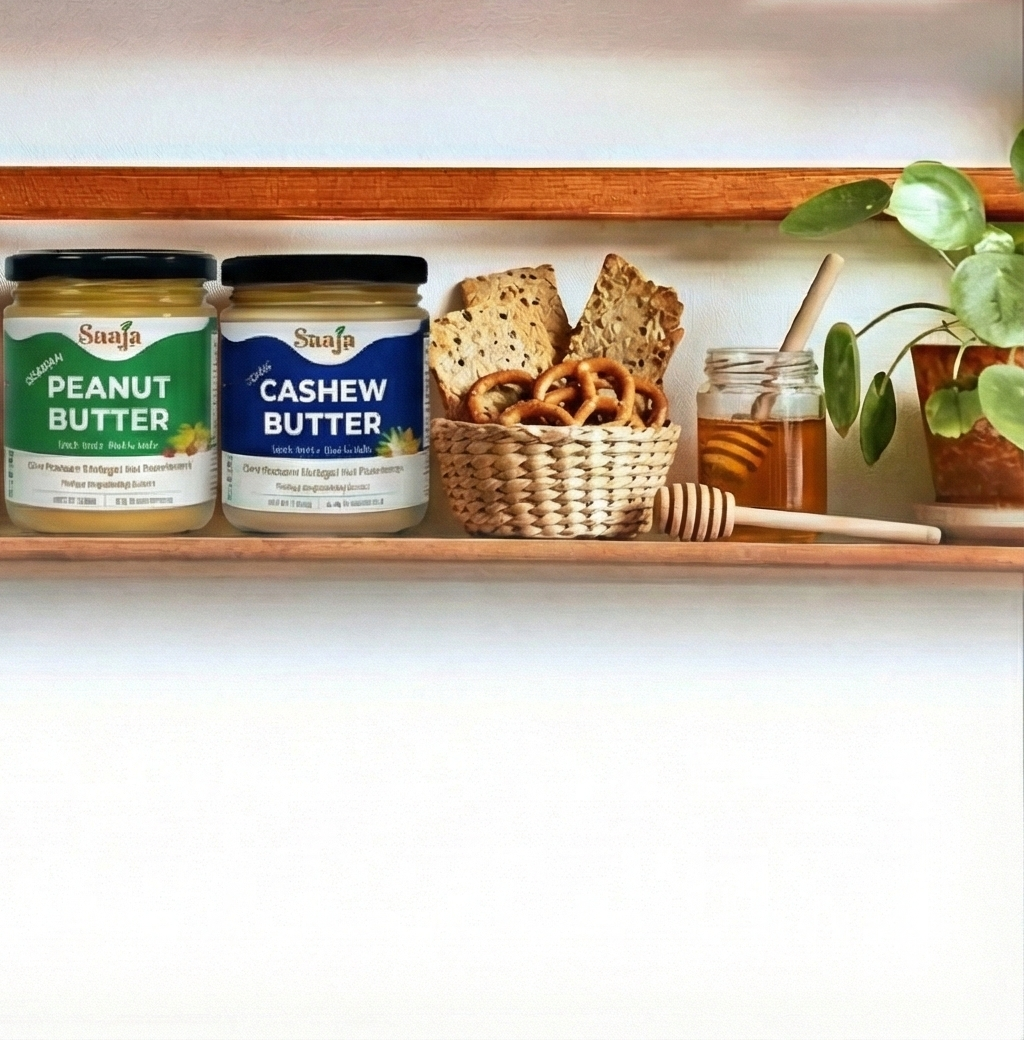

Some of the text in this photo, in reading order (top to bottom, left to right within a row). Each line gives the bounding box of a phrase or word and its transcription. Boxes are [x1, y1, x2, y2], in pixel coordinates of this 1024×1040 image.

[47, 375, 171, 400] PEANUT
[259, 378, 388, 403] CASHEW
[49, 407, 169, 431] BUTTER
[264, 411, 382, 436] BUTTER
